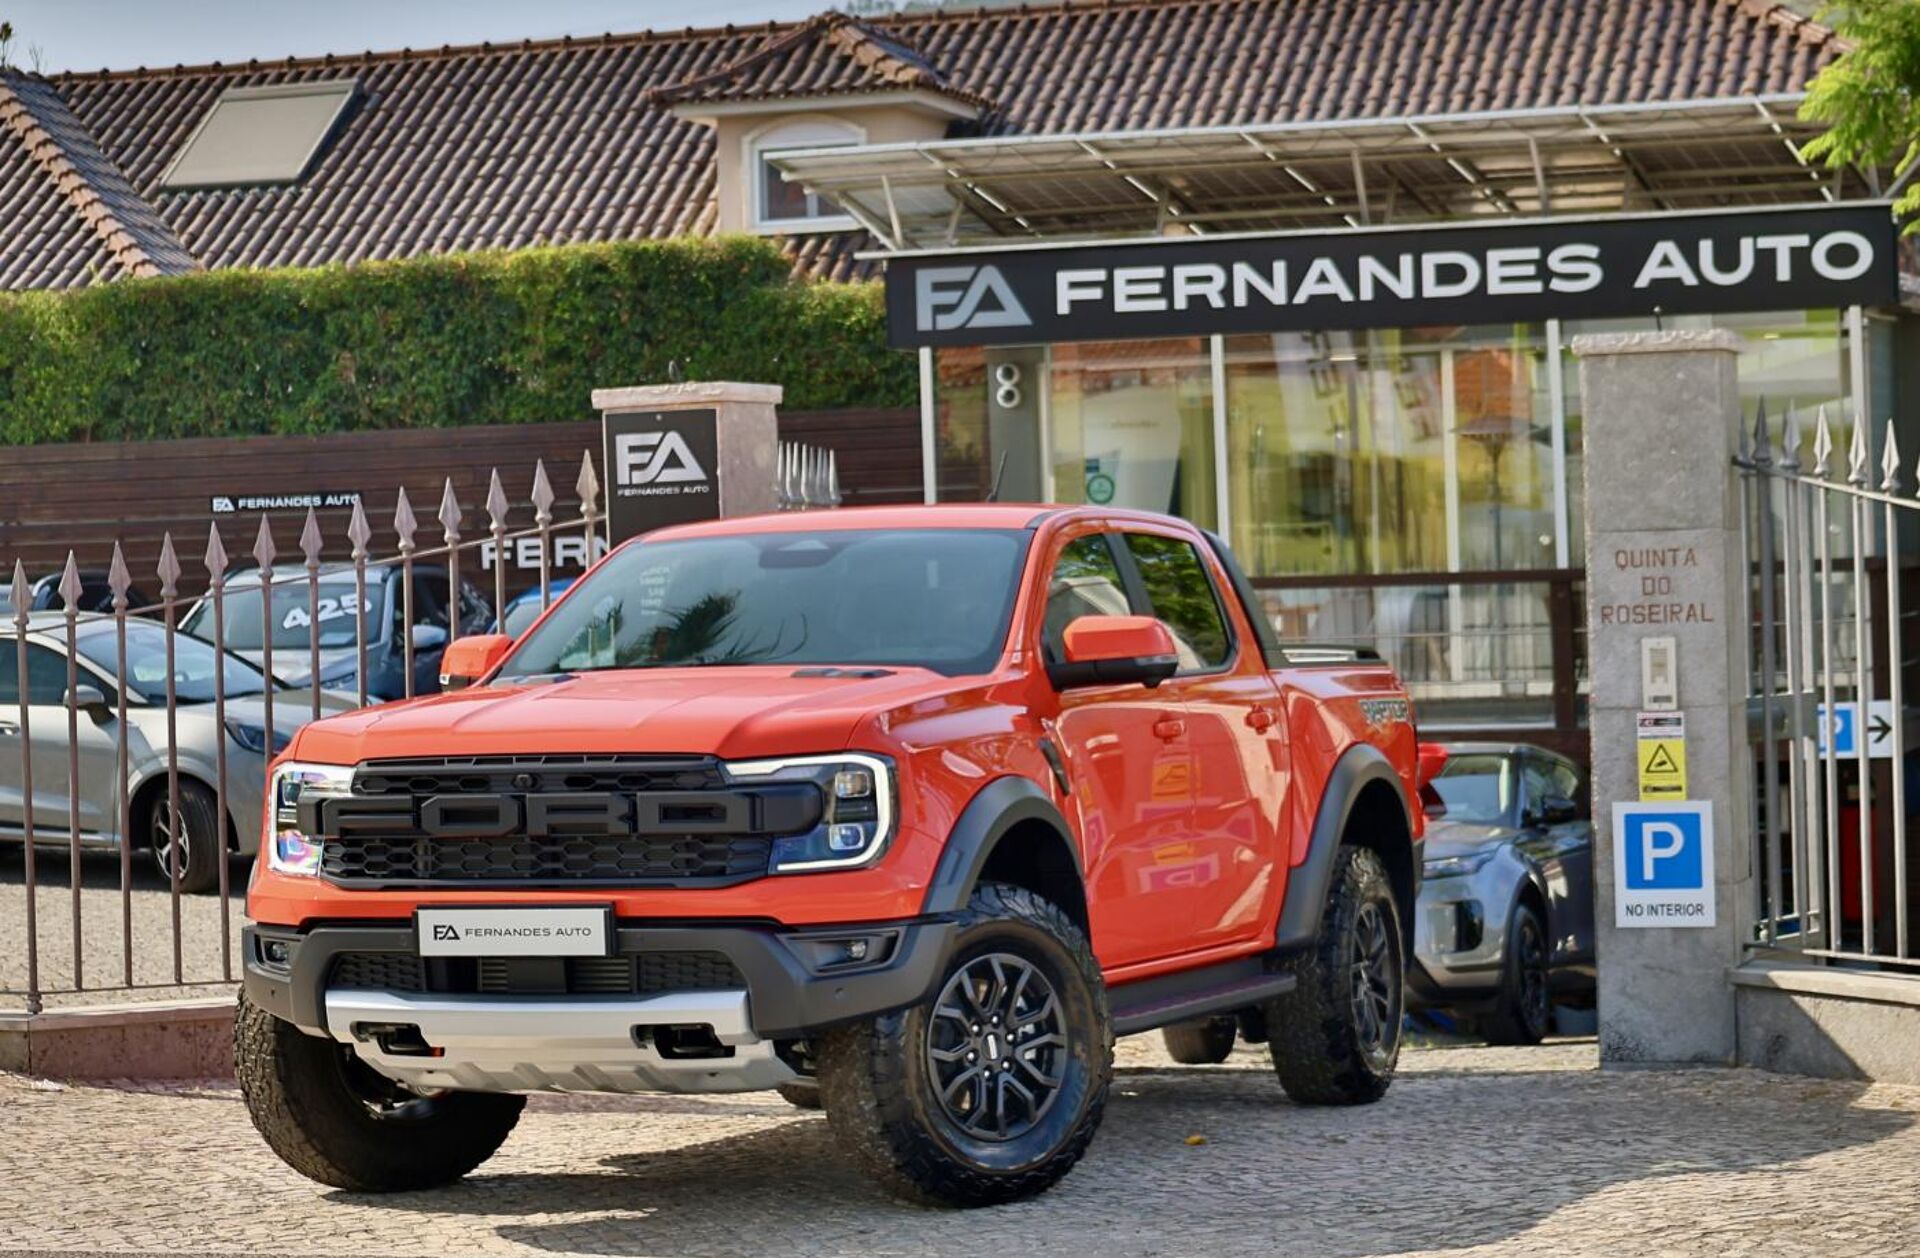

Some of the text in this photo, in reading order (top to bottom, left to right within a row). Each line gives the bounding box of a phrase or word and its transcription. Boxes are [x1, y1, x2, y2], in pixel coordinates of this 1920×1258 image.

[915, 230, 1875, 331] FA FERNANDES AUTO
[615, 429, 708, 485] FA
[617, 484, 710, 497] FERNANDES AUTO
[212, 497, 235, 512] FA
[238, 496, 321, 510] FERNANDES
[1615, 548, 1698, 571] QUINTA
[1641, 576, 1672, 596] DO
[283, 594, 372, 630] A25
[1601, 603, 1714, 625] ROSEIRAL
[322, 792, 751, 835] FORD
[1641, 821, 1684, 881] P
[1625, 903, 1705, 917] NO INTERIOR
[433, 925, 592, 941] FA FERNANDES AUTO
